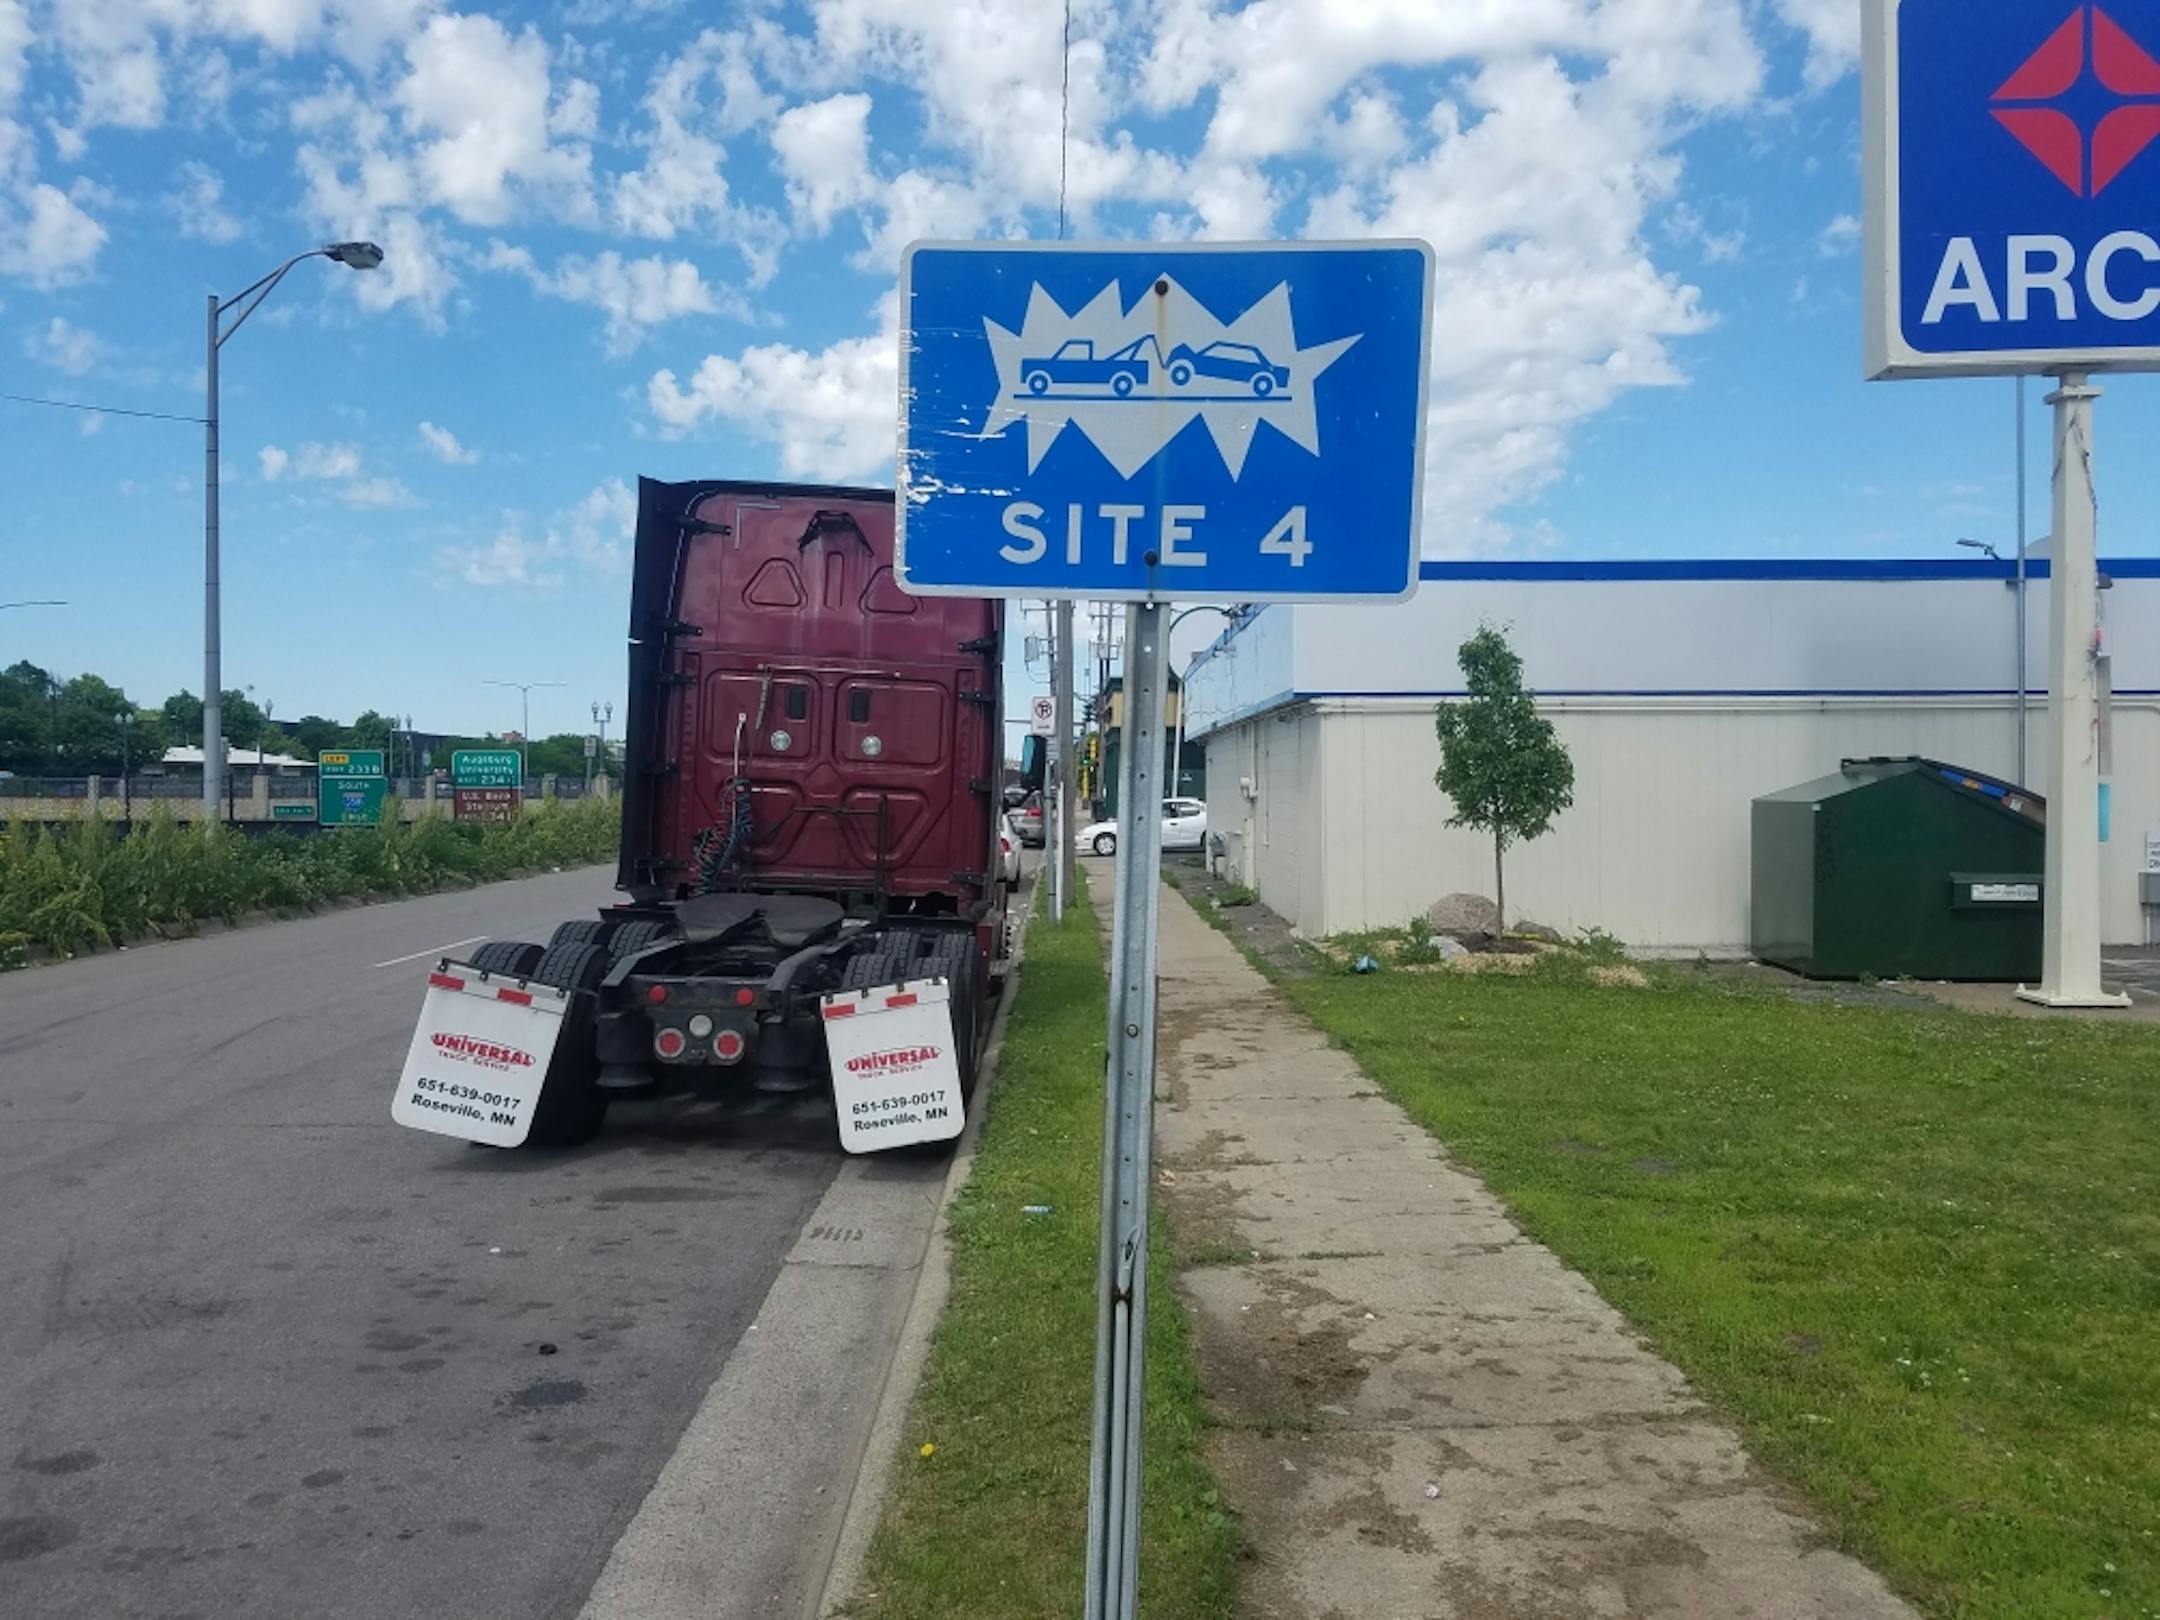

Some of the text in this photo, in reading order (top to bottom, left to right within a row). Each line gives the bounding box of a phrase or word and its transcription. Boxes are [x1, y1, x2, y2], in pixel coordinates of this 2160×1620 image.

[999, 501, 1314, 567] SITE 4
[417, 1077, 522, 1110] 651-639-0017
[851, 1089, 946, 1115] 651-639-0017
[410, 1093, 518, 1128] Roseville, MN
[853, 1106, 949, 1132] Roseville, MN
